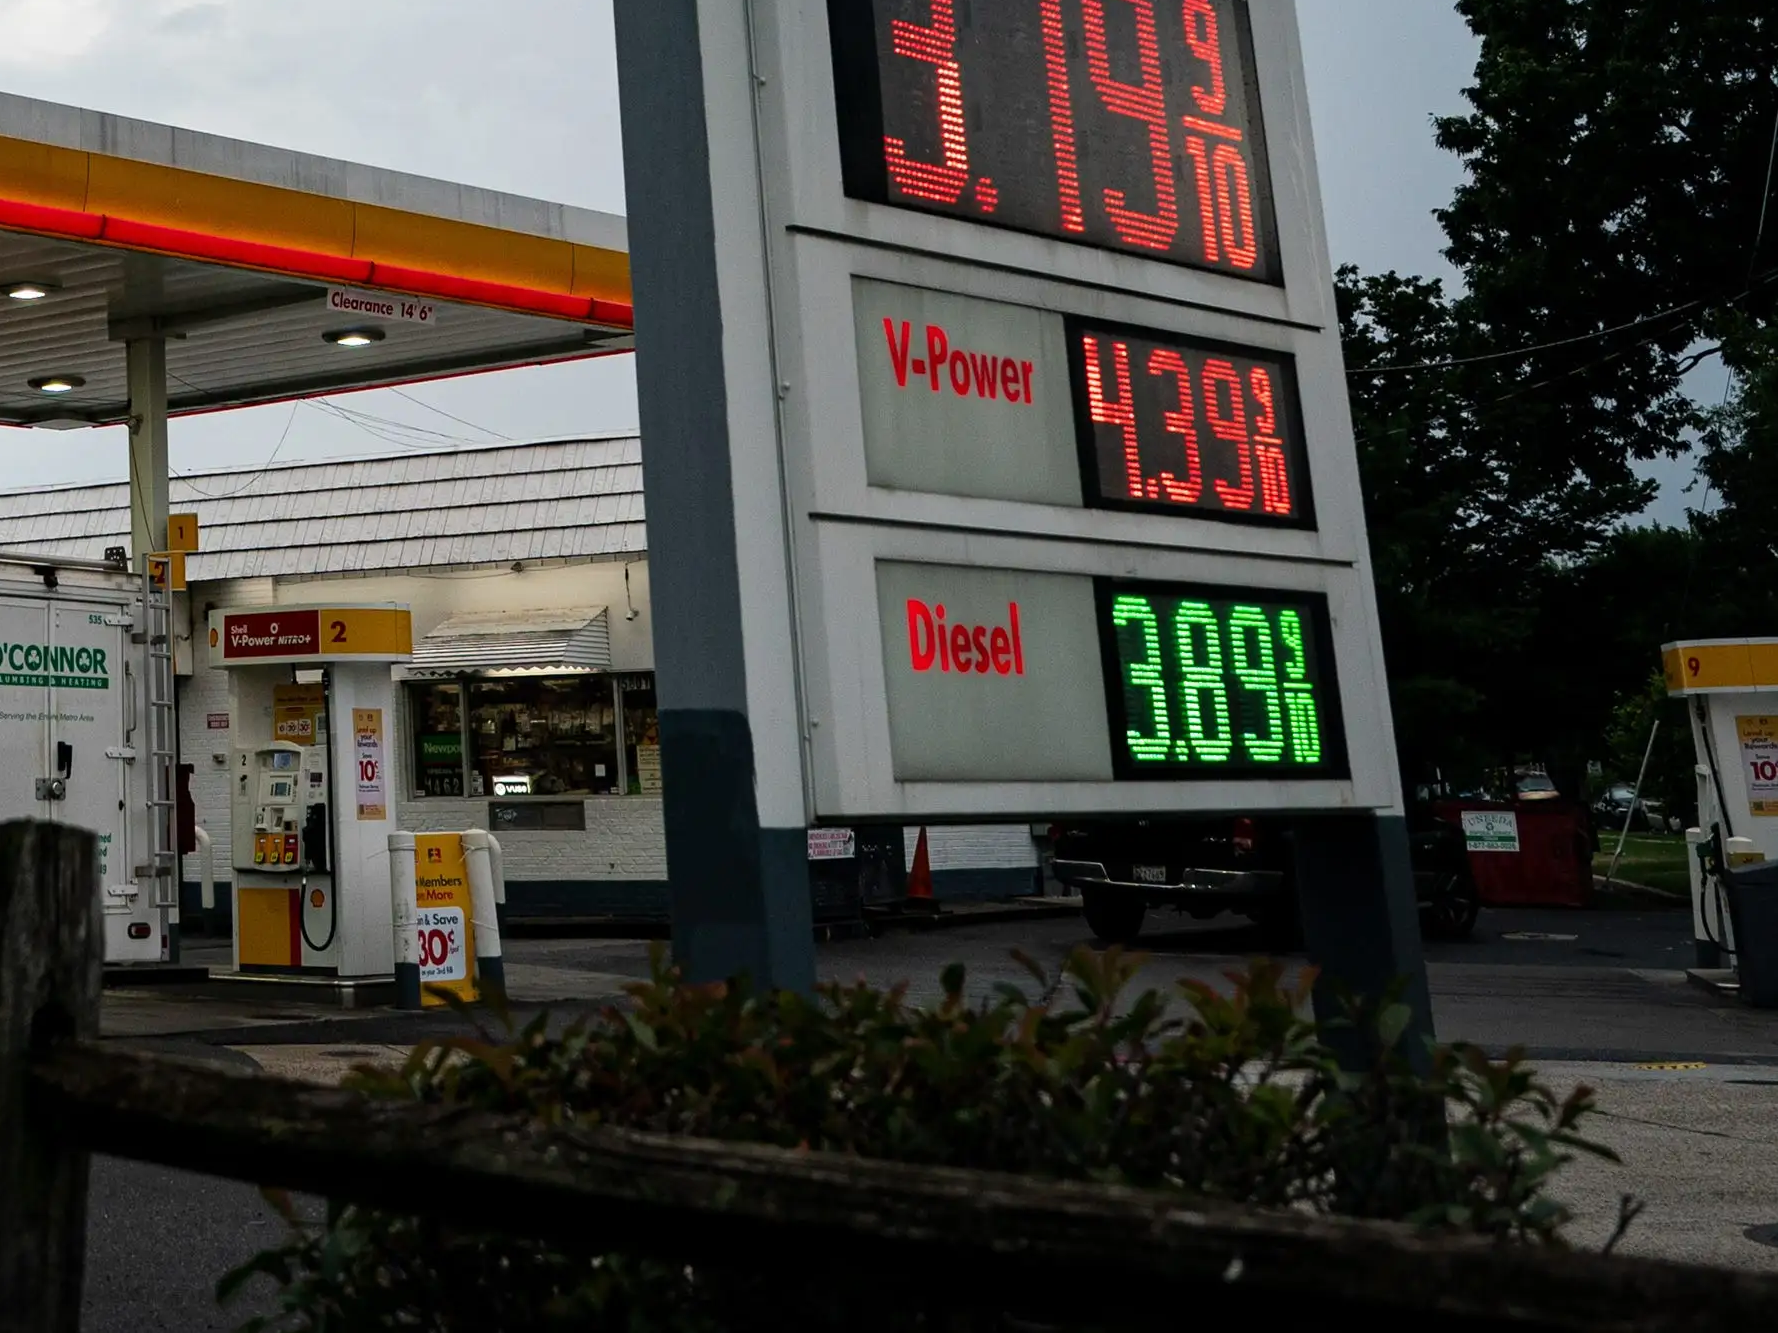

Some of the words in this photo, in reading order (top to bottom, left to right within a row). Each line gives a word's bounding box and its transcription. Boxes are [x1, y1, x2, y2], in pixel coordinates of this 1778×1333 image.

[331, 291, 394, 316] Clearance
[883, 317, 1034, 405] V-Power
[154, 561, 166, 583] 2
[89, 615, 103, 625] 535
[230, 624, 248, 635] Shell
[331, 620, 347, 643] 2
[231, 635, 275, 648] V-Power
[906, 598, 1024, 675] Diesel
[1688, 656, 1700, 676] 9
[62, 678, 102, 687] HEATING
[0, 711, 24, 721] Serving
[427, 889, 453, 901] More
[433, 914, 458, 925] Save
